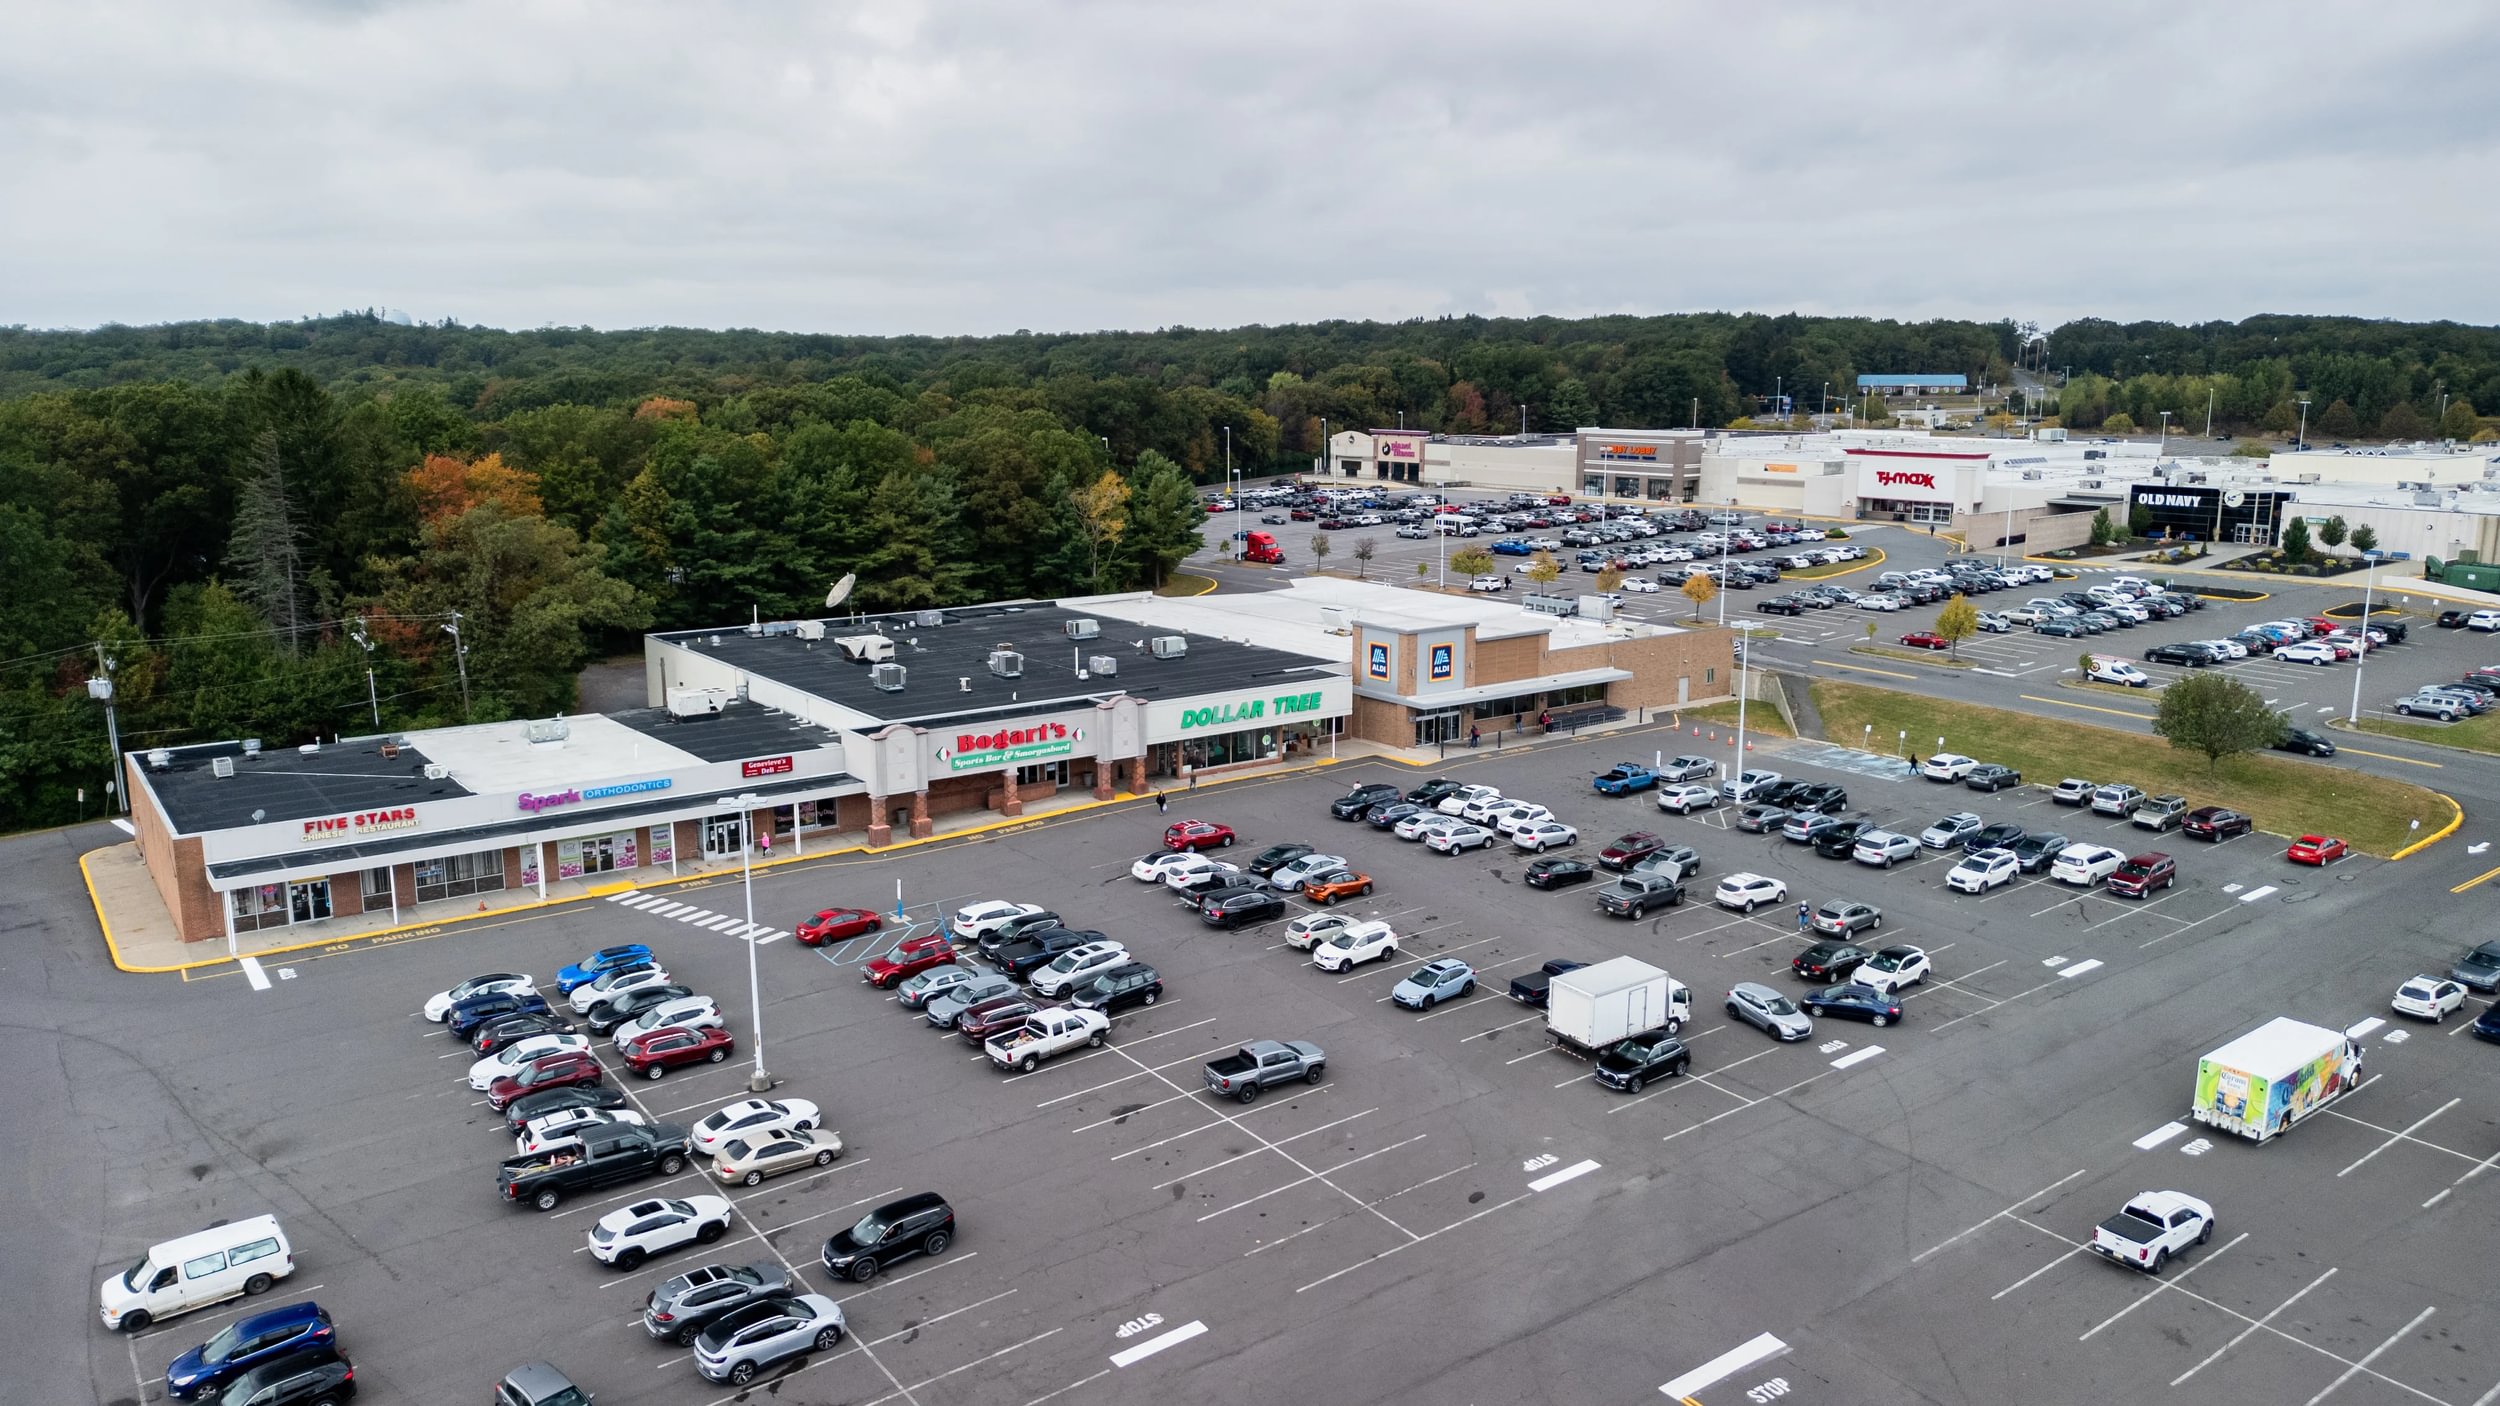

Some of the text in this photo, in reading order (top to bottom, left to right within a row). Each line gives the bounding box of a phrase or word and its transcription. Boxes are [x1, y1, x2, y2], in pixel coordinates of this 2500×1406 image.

[1630, 445, 1657, 455] LOBBY
[2138, 493, 2201, 507] OLD NAVY
[1371, 663, 1387, 673] ALDI
[1433, 664, 1450, 674] ALDI
[1181, 691, 1323, 729] DOLLAR TREE
[956, 723, 1067, 753] Bogart's
[954, 743, 1070, 769] Sports Bar & Smorgasbord
[761, 767, 775, 775] Deli
[518, 779, 671, 813] Spark ORTHODONTICS
[300, 819, 420, 842] CHINESE RESTAURANT
[304, 807, 415, 833] FIVE STARS
[325, 927, 441, 952] NO PARKING
[1523, 1153, 1560, 1172] STOP
[1115, 1312, 1164, 1338] STOP
[1746, 1377, 1791, 1404] STOP
